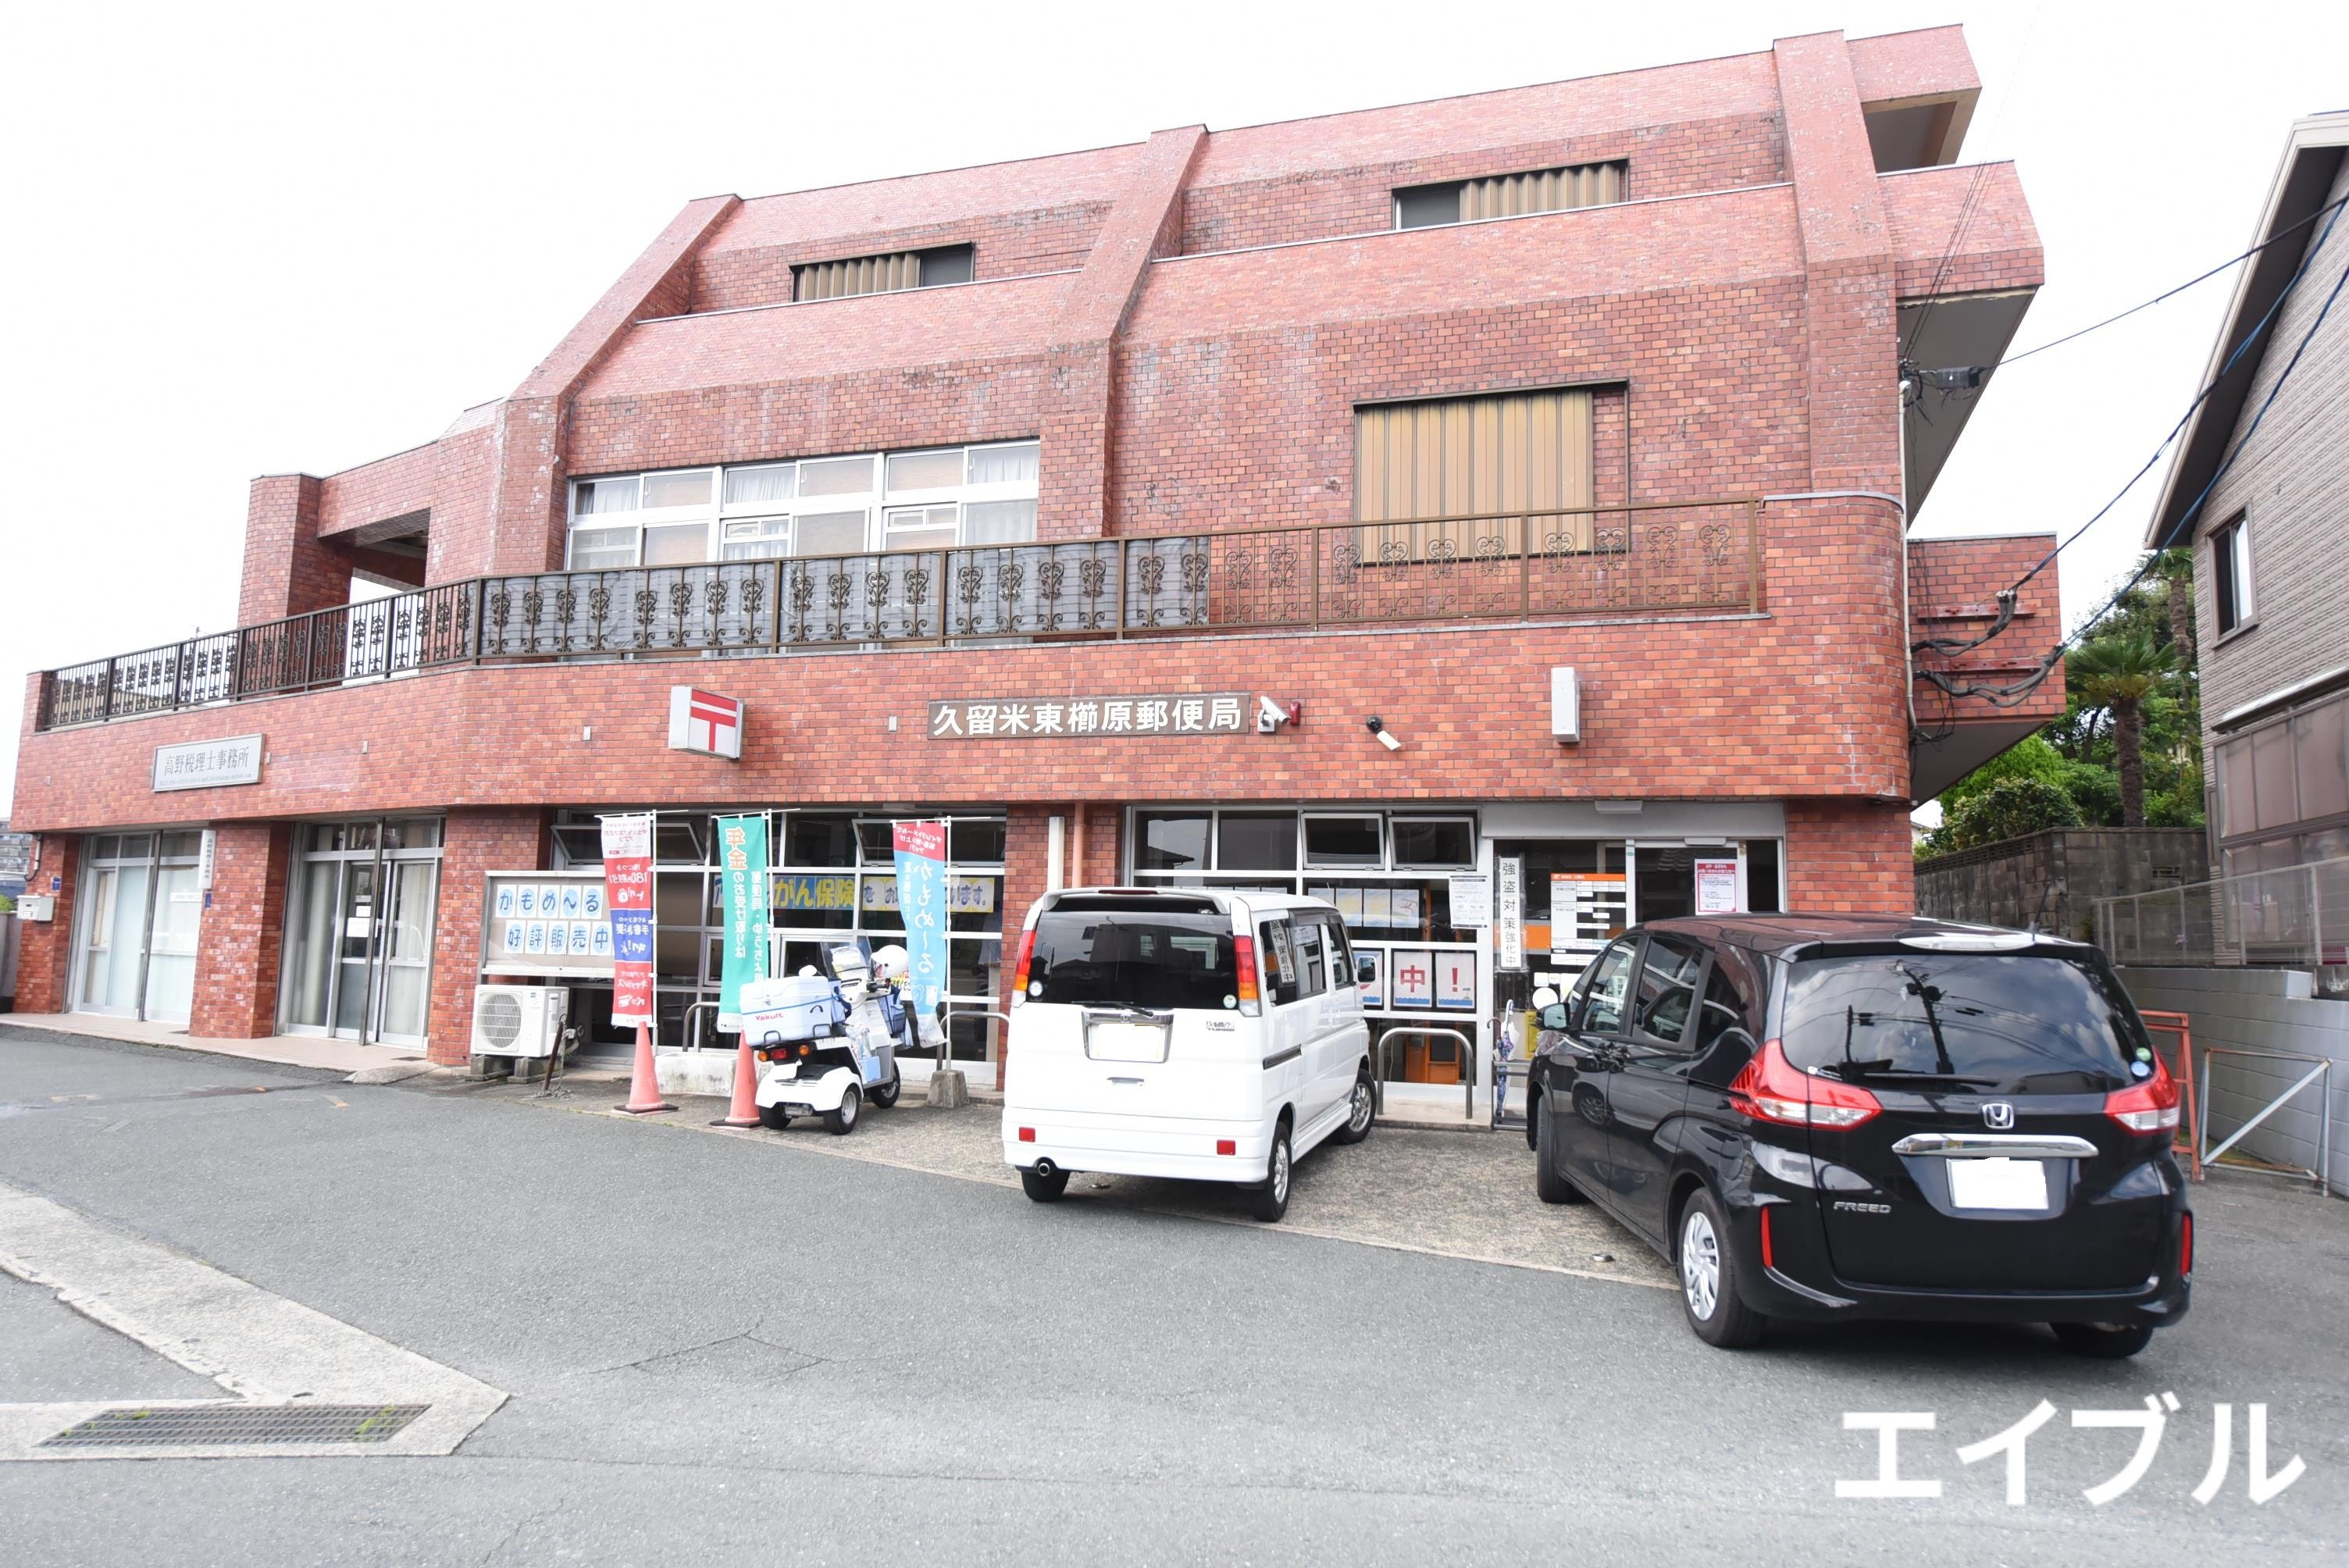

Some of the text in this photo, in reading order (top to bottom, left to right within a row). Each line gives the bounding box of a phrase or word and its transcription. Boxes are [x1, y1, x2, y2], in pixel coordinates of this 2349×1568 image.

[932, 698, 1242, 736] 久留米東櫛原郵便局
[164, 747, 250, 775] 高野税理士事務所
[774, 878, 854, 908] がん保険
[1502, 862, 1517, 965] 強盗対策強化中
[508, 928, 608, 949] 好評販売中
[755, 1012, 784, 1021] Yakult
[1833, 1201, 1891, 1213] FREED
